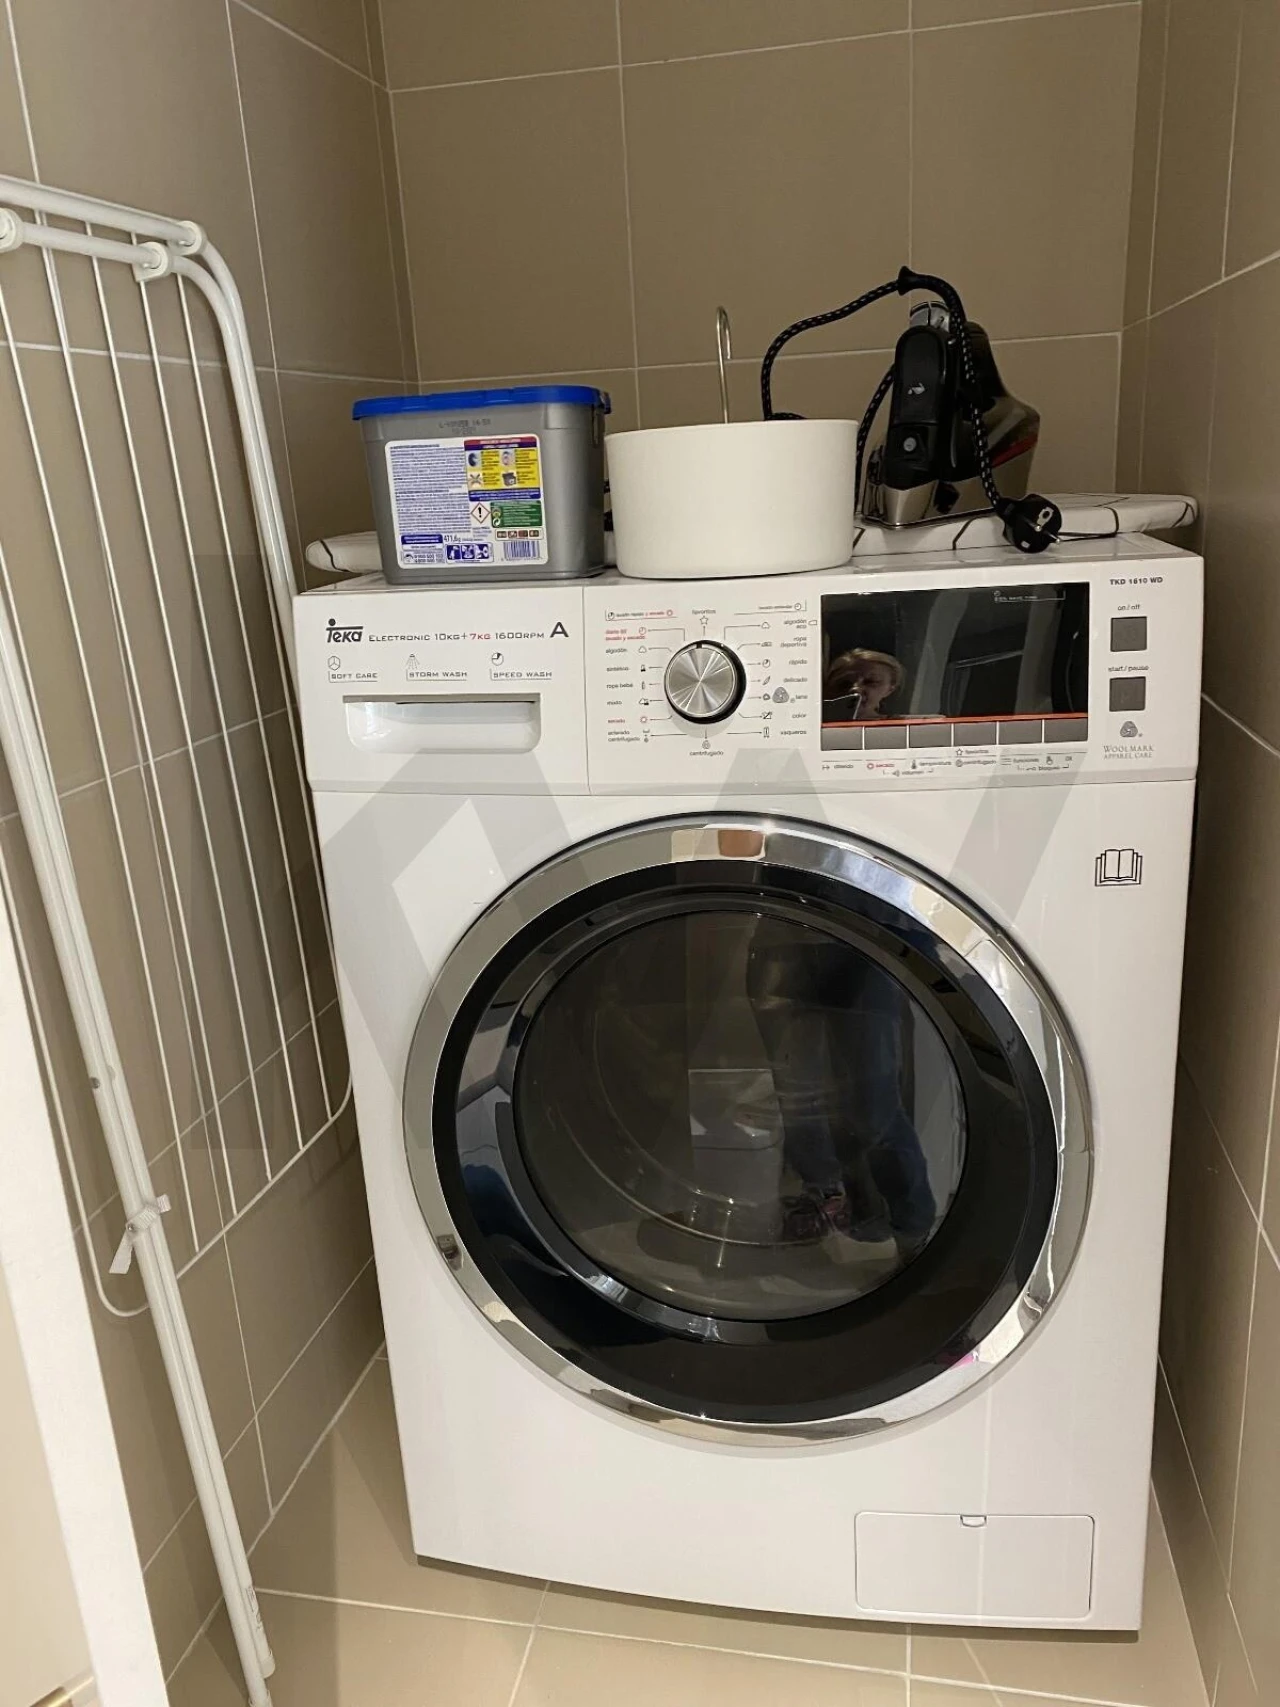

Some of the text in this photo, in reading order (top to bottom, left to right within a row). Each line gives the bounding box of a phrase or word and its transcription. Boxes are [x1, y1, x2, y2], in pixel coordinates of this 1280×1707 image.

[1150, 576, 1164, 584] WD
[550, 621, 569, 638] A
[331, 672, 352, 680] SOFT
[493, 671, 523, 679] SPEED
[1103, 744, 1154, 753] WOOLMARK
